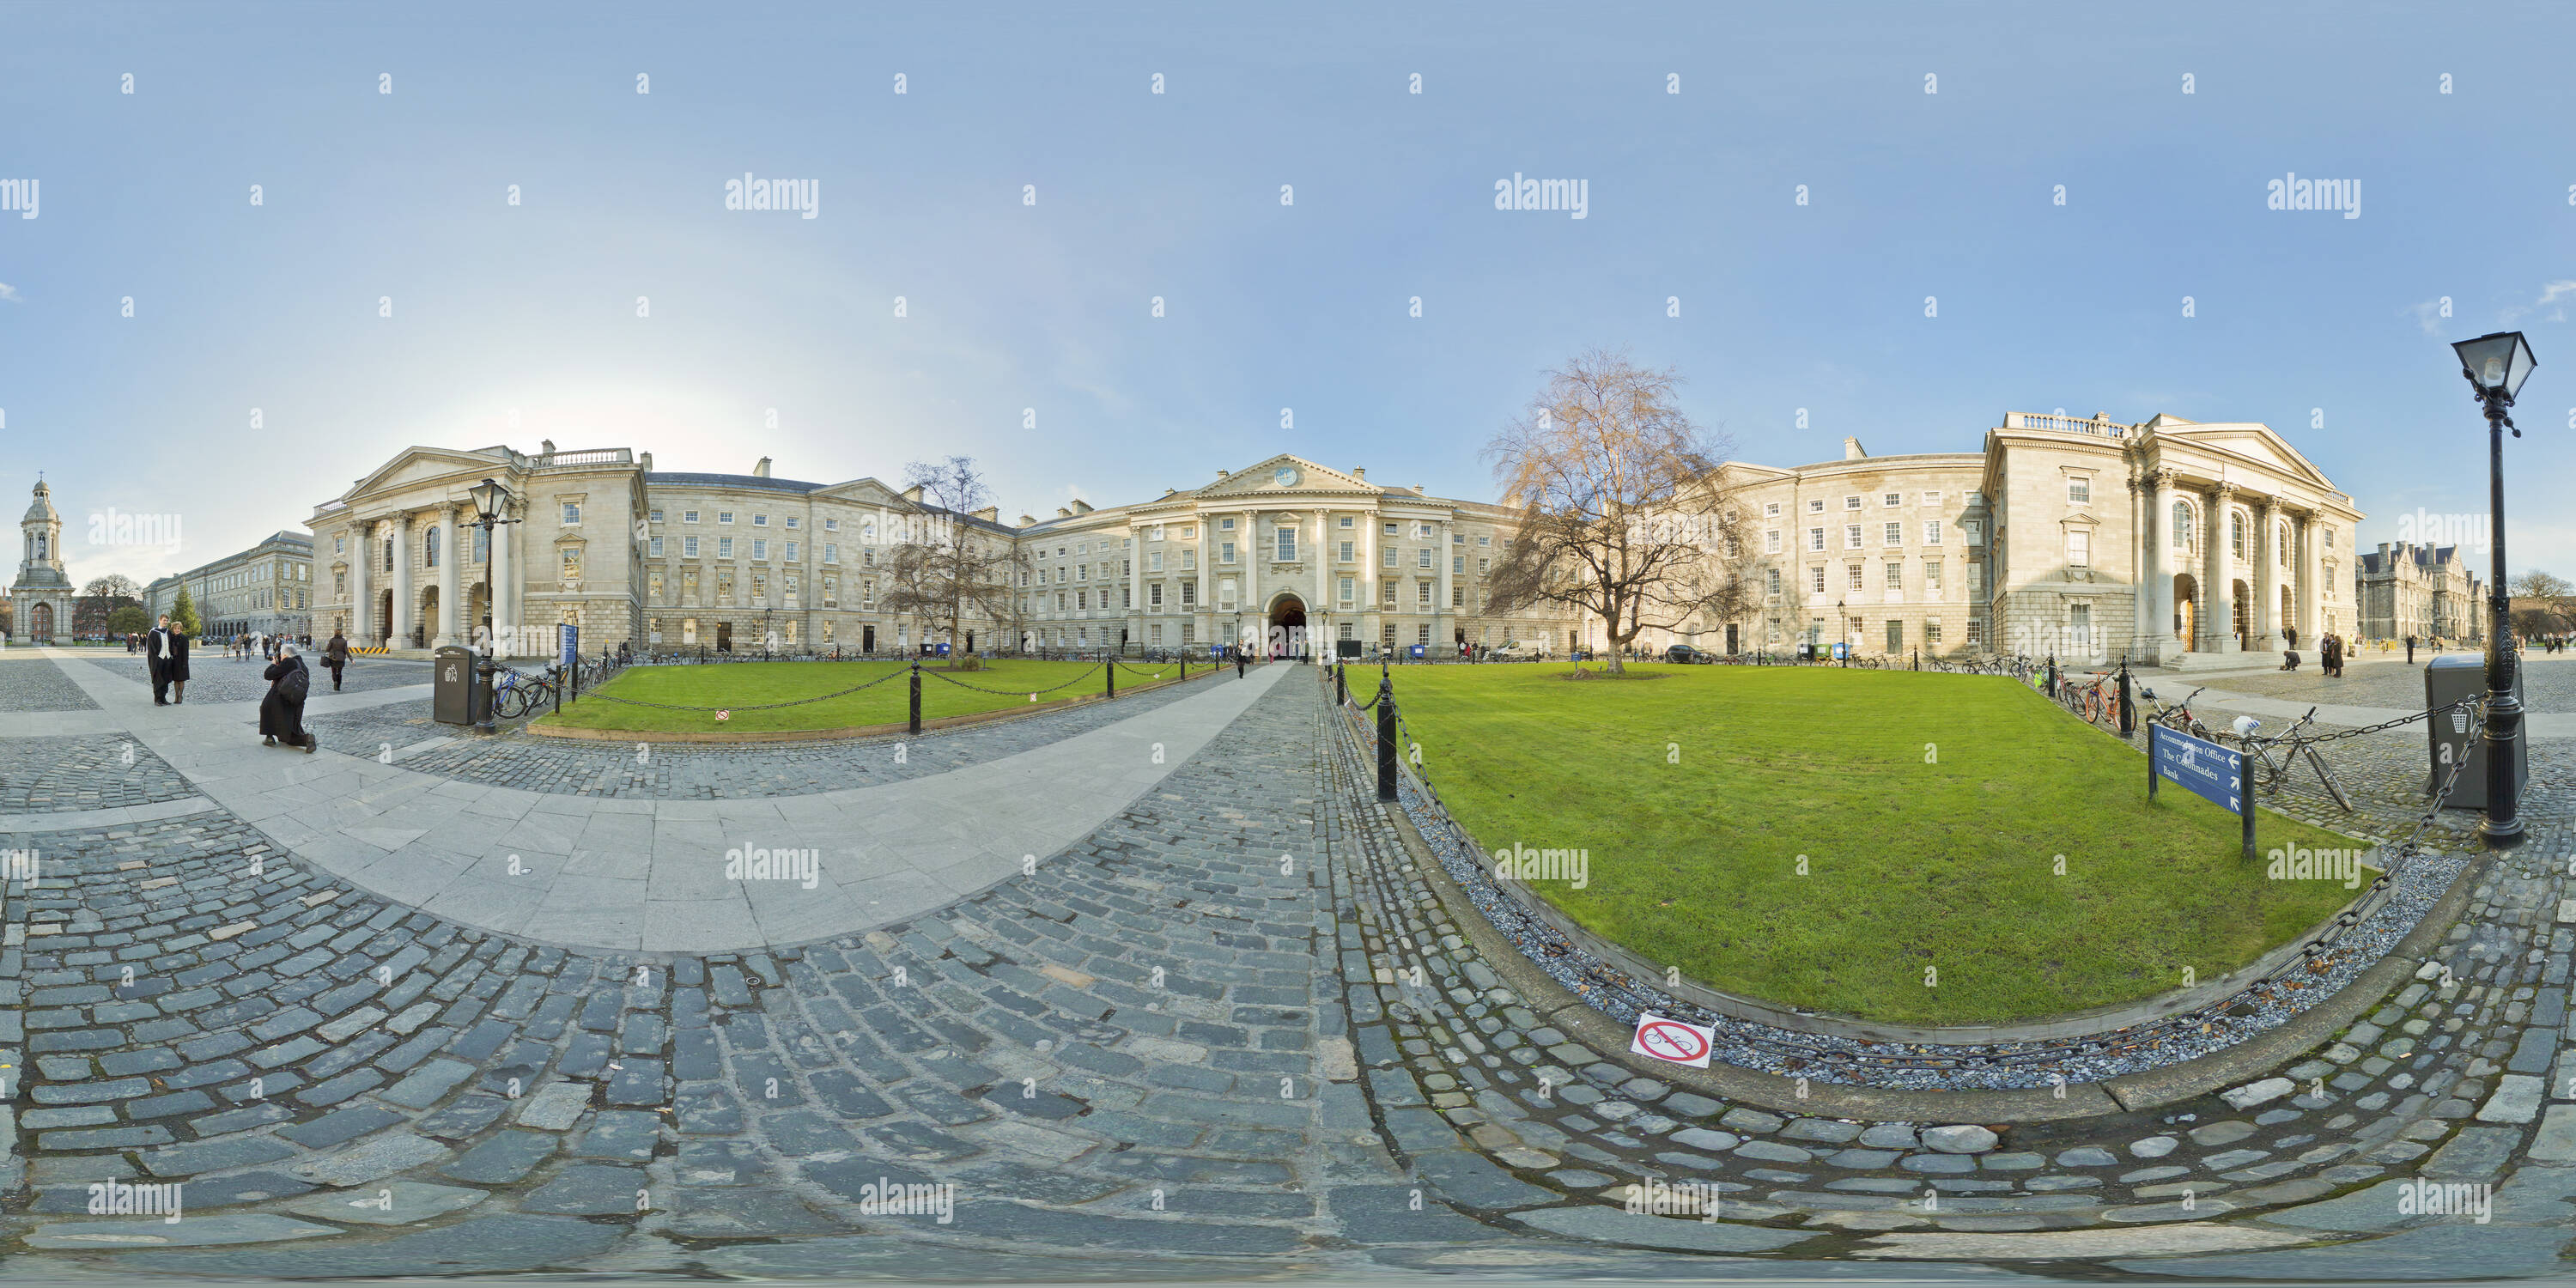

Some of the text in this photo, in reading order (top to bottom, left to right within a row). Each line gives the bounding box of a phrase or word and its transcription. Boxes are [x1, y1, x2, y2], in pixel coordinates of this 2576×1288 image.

[2160, 731, 2226, 762] Accommodation Office
[2162, 748, 2218, 781] The Colonnades
[2163, 764, 2179, 781] Bank
